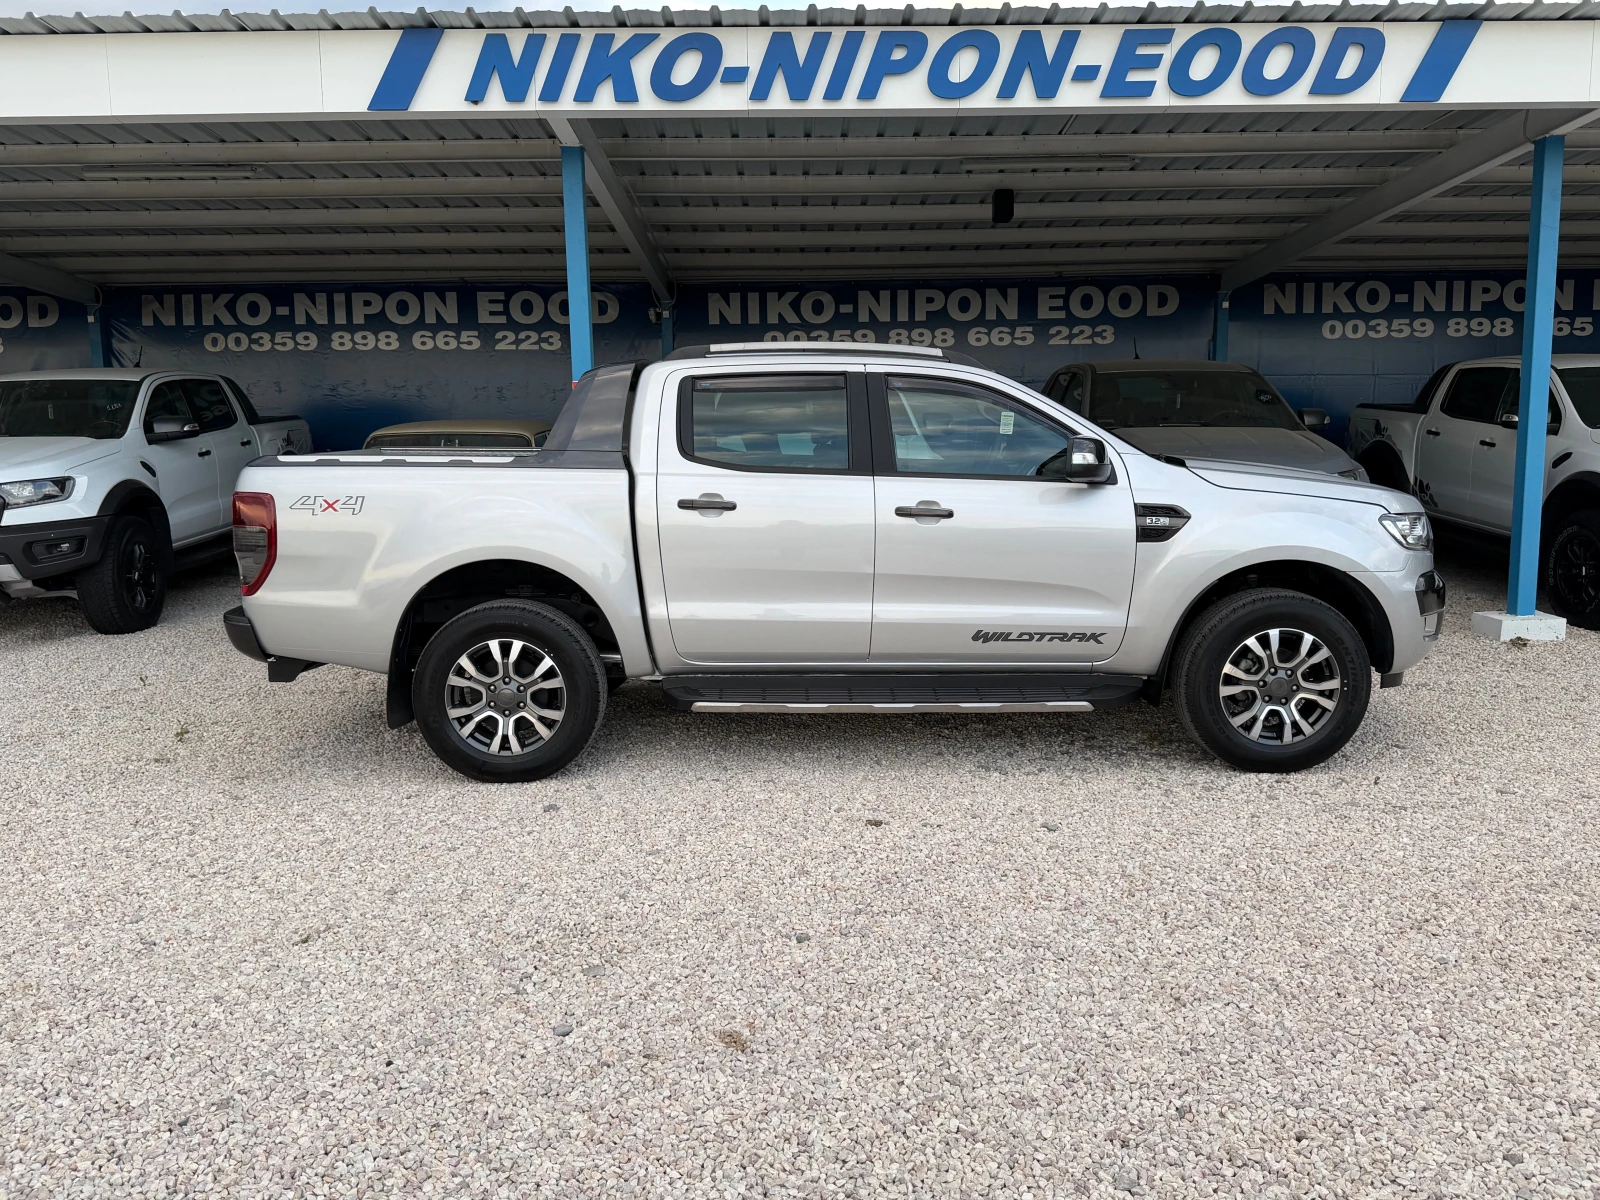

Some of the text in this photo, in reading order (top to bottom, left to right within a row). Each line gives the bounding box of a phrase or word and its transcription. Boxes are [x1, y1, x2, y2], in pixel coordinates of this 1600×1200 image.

[141, 291, 459, 327] NIKO-NIPON
[708, 284, 1180, 325] NIKO-NIPON EOOD
[888, 328, 955, 347] 898
[967, 326, 1035, 347] 665
[1048, 325, 1115, 345] 223
[1321, 316, 1594, 340] 00359 898 65
[203, 330, 562, 352] 00359 898 665 223
[971, 629, 1108, 645] WILDTRAK
